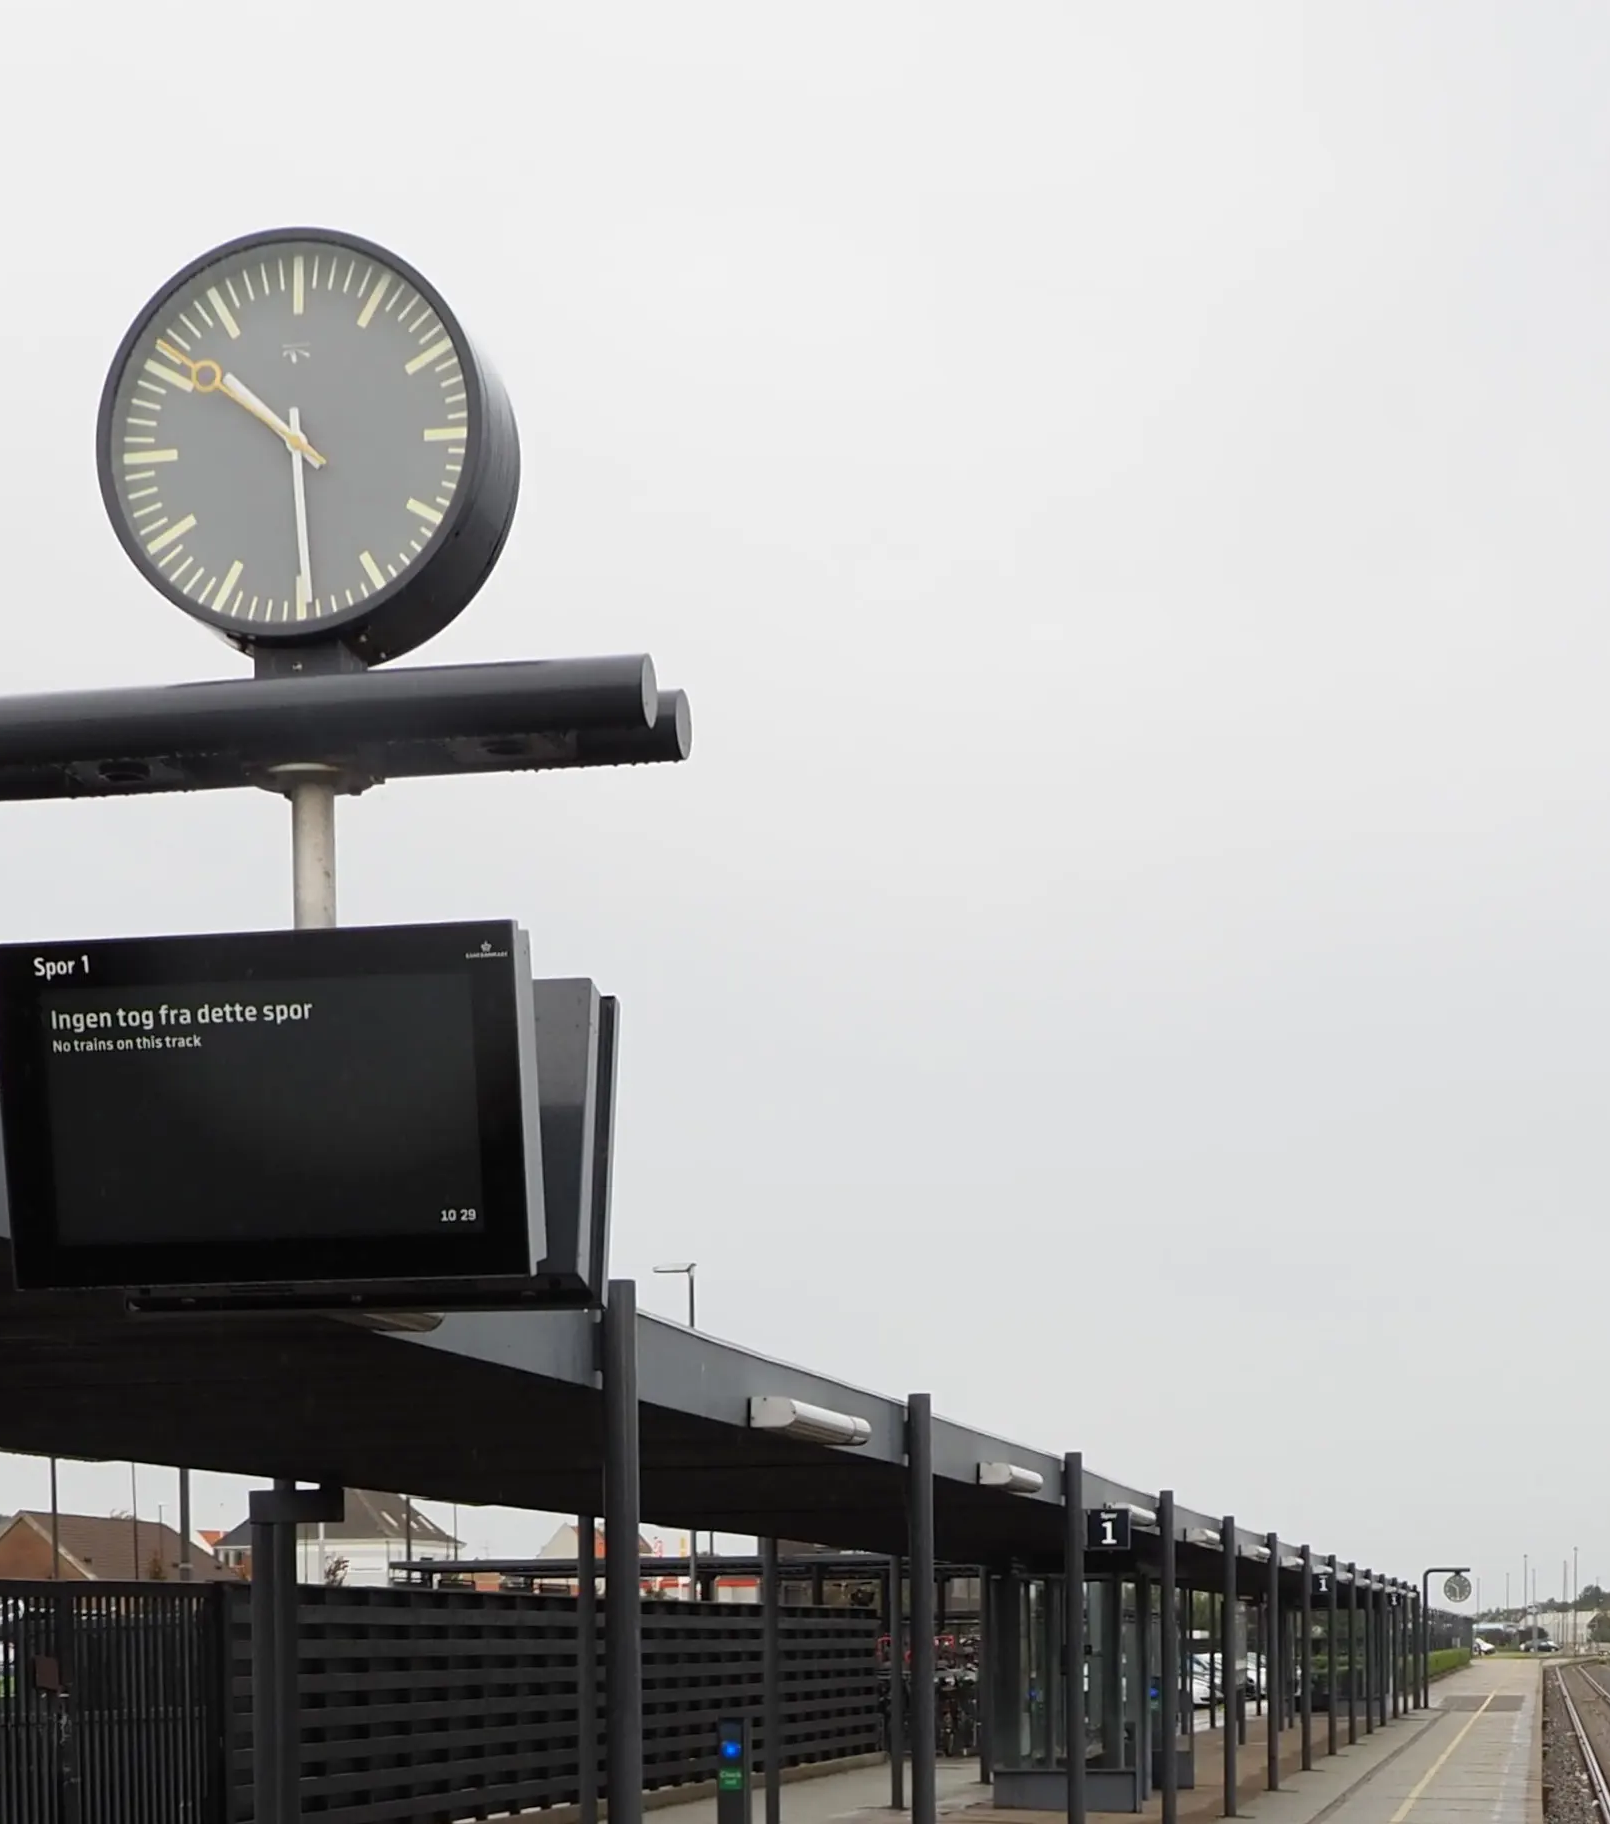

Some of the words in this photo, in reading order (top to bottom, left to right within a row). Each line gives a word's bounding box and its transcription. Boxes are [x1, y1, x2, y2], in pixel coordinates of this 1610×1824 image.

[33, 957, 75, 981] Spor
[81, 955, 90, 974] 1
[51, 1010, 112, 1033] Ingen
[116, 1008, 154, 1031] tog
[158, 1004, 192, 1026] fra
[197, 1002, 258, 1024] dette
[262, 1003, 313, 1025] spor
[52, 1039, 72, 1053] No
[73, 1037, 114, 1052] trains
[116, 1039, 134, 1051] on
[135, 1035, 163, 1050] this
[164, 1034, 202, 1049] track
[440, 1209, 457, 1222] 10
[459, 1208, 477, 1221] 29
[1101, 1521, 1118, 1545] 1
[1319, 1578, 1329, 1592] 1
